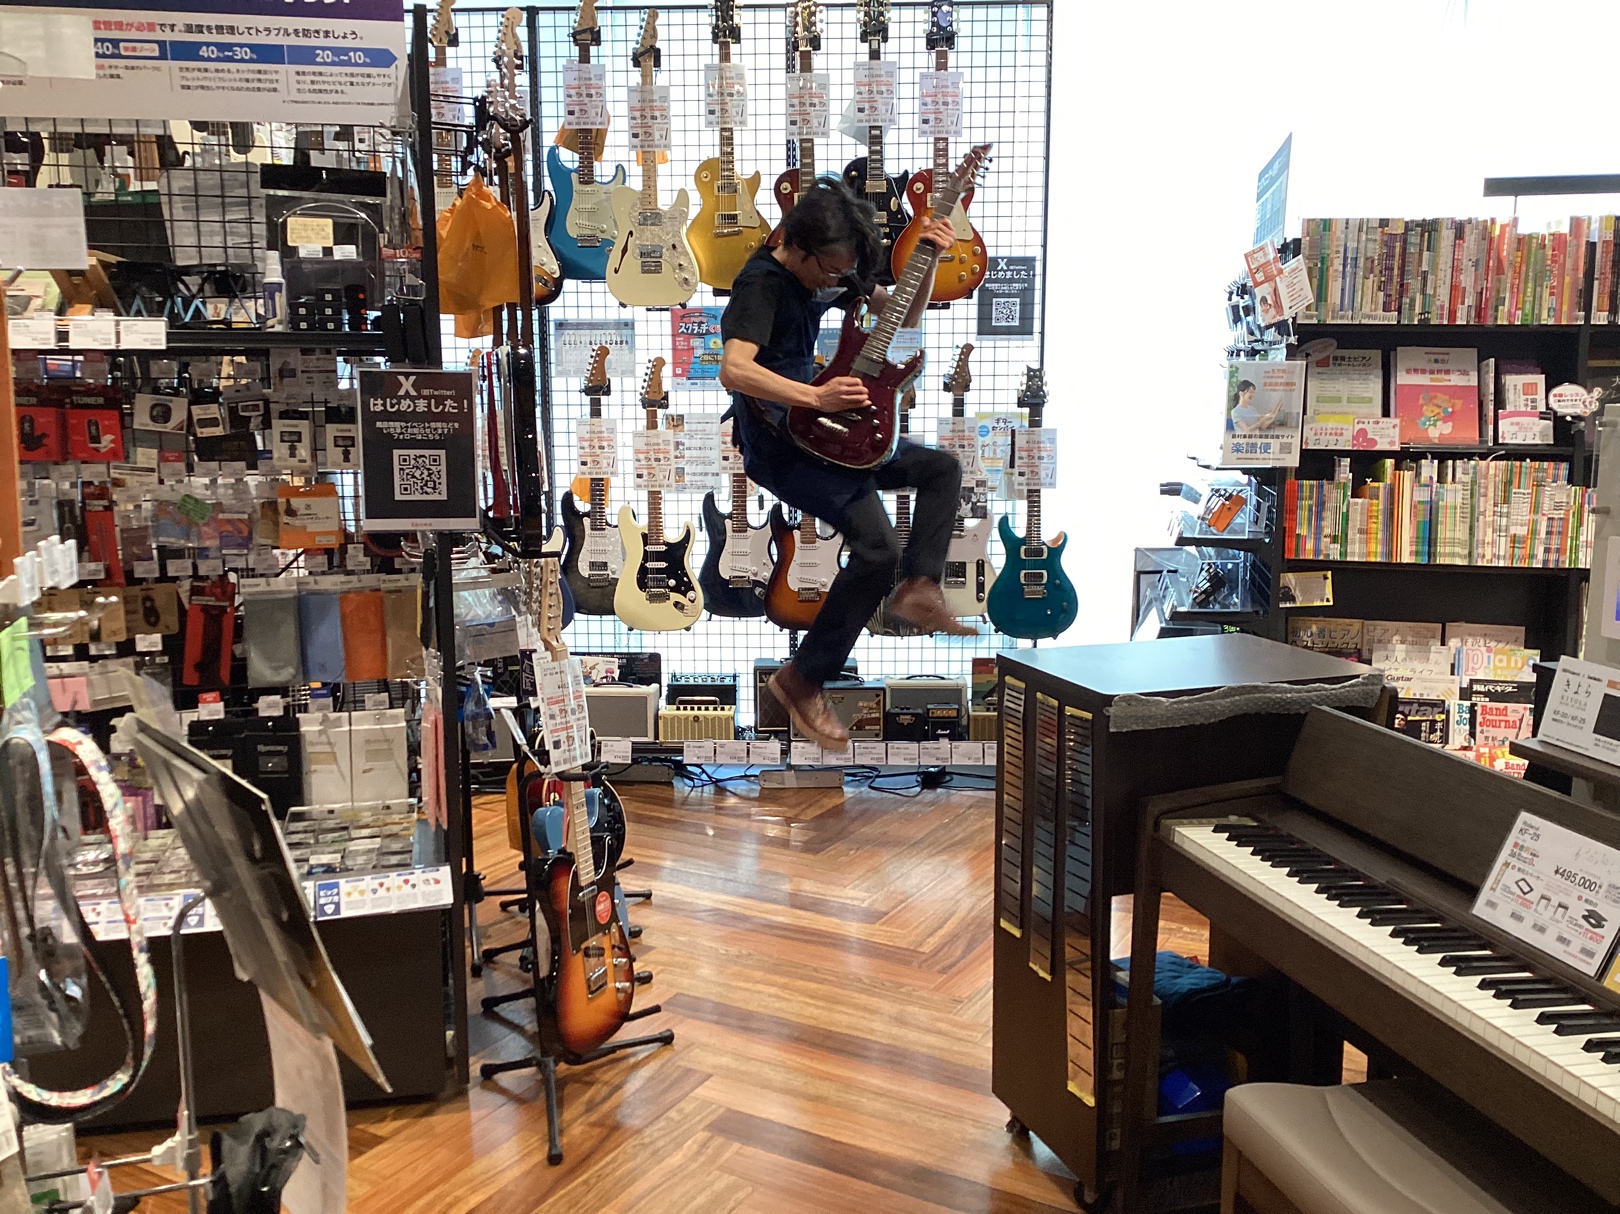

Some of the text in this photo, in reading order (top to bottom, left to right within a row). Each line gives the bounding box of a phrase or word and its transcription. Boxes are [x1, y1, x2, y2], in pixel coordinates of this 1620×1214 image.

[996, 258, 1008, 270] X
[397, 375, 417, 396] X
[369, 398, 468, 413] はじめました！
[1231, 441, 1272, 455] 楽譜便
[1292, 627, 1360, 641] 初心者ピアノ
[1464, 646, 1537, 677] piano
[1386, 674, 1414, 683] Guitar
[1472, 684, 1518, 693] 現代ギター
[1563, 678, 1592, 698] きよら
[1480, 704, 1508, 717] Band
[1504, 761, 1526, 771] Band
[1522, 820, 1540, 832] Roland
[1518, 826, 1542, 842] KF-25
[1553, 864, 1598, 893] ¥495,000
